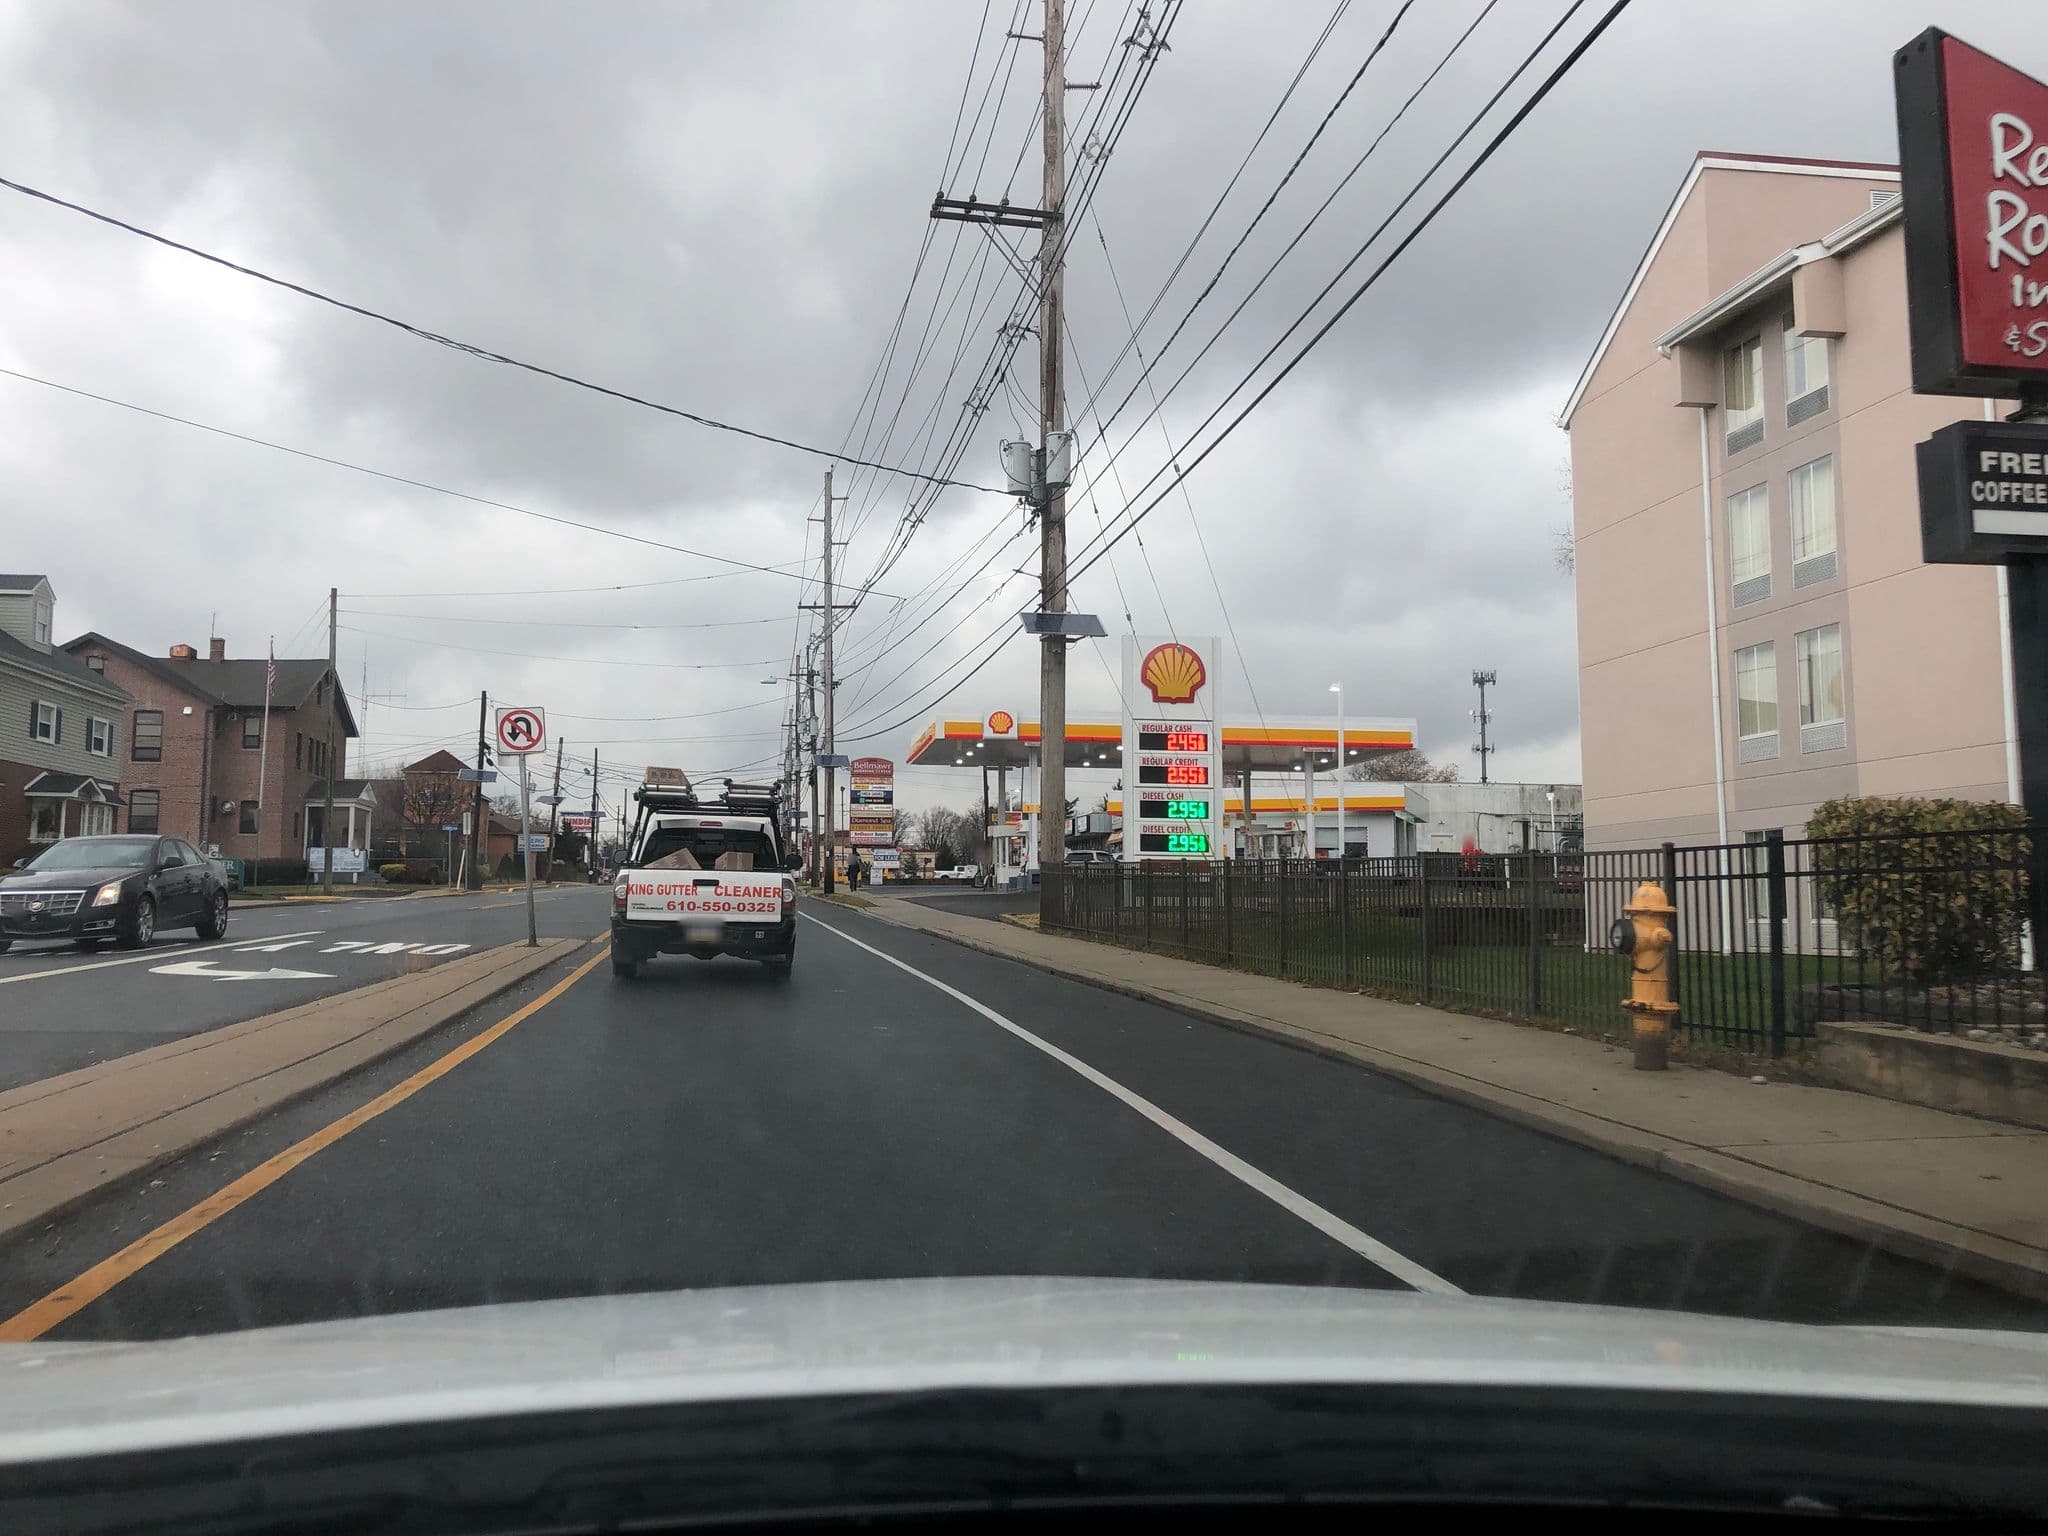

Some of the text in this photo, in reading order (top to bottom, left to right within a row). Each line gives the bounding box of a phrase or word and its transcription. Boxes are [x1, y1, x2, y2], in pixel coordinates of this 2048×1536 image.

[1980, 451, 2048, 476] FRE
[1971, 480, 2048, 504] COFFEE
[1141, 724, 1192, 733] REGULAR CASH
[854, 761, 891, 769] Bellmawr
[1142, 758, 1198, 766] REGULAR CREDIT
[1142, 792, 1184, 800] DIESEL CASH
[1142, 825, 1191, 834] DIESEL CREDIT
[628, 884, 782, 898] KING GUTTER CLEANER
[667, 901, 776, 913] 610-550-0325
